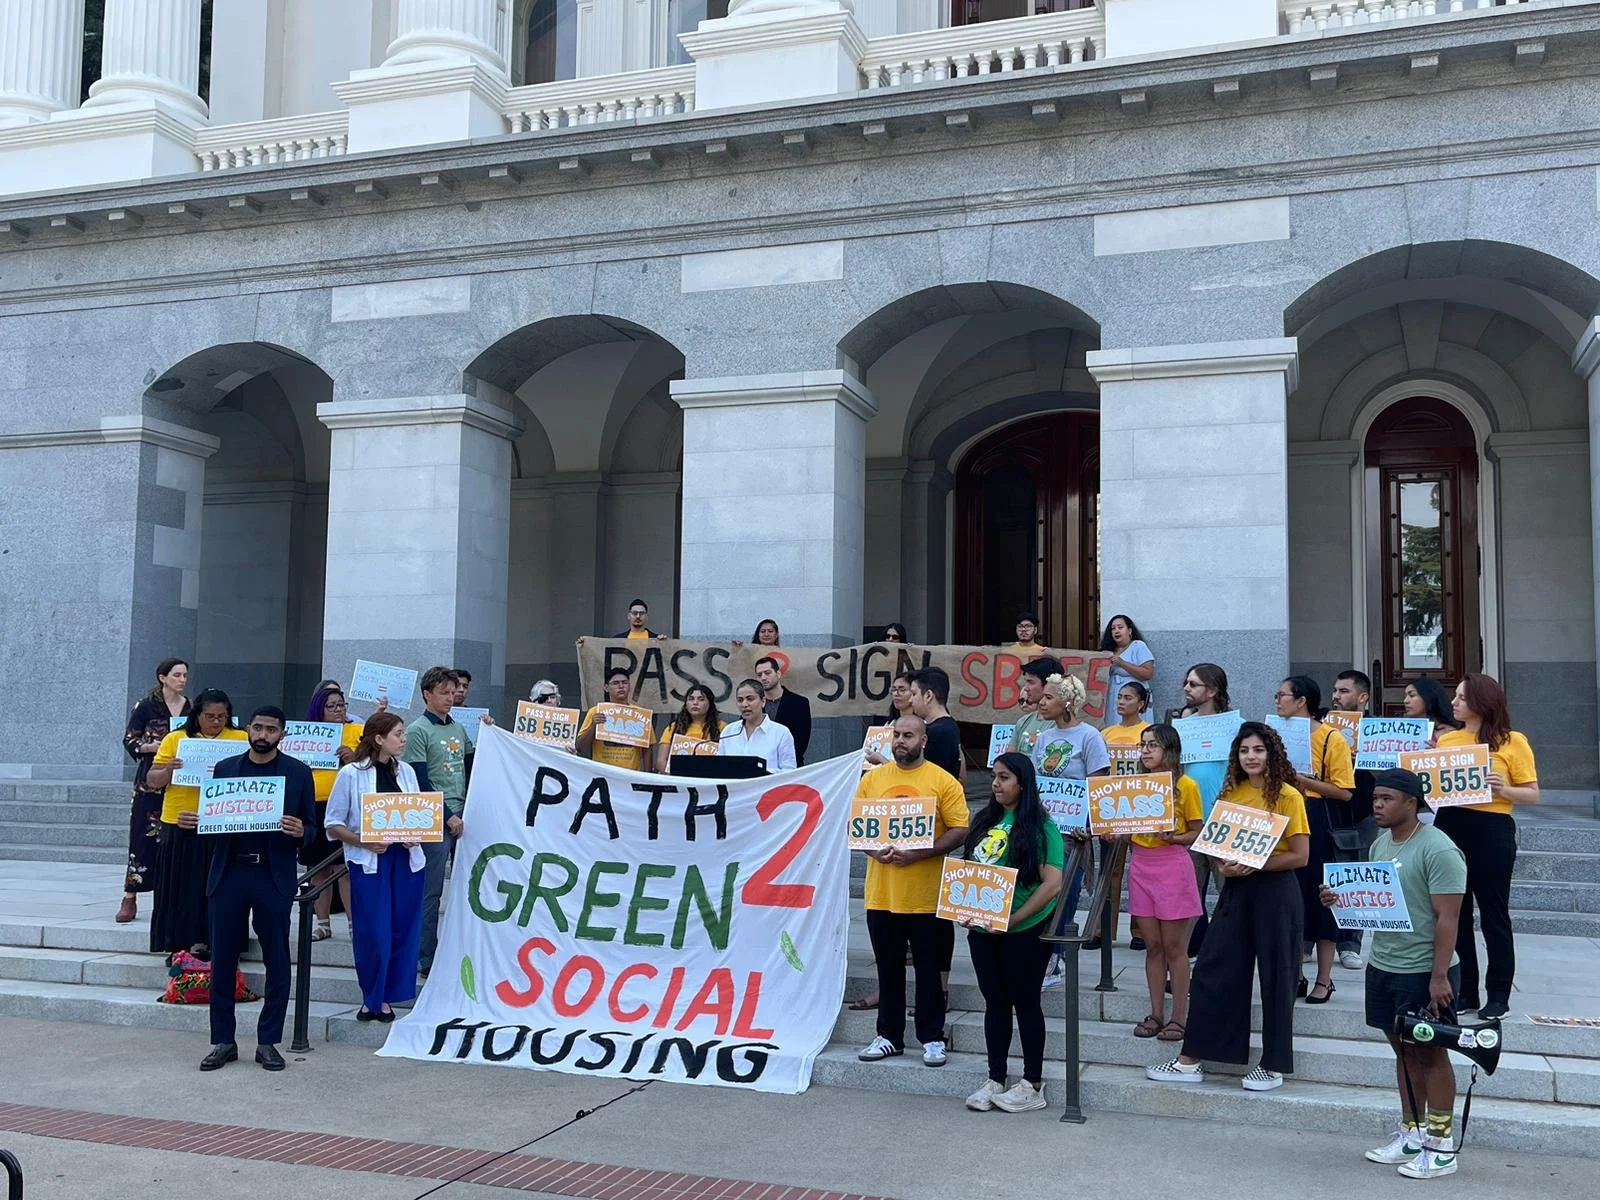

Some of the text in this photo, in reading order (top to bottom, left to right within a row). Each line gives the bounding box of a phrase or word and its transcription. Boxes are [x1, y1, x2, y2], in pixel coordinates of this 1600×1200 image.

[604, 647, 733, 704] PASS
[959, 652, 1022, 710] SB
[526, 708, 544, 718] PASS
[552, 712, 570, 721] SIGN
[634, 712, 650, 724] THAT
[286, 724, 335, 738] LIMATE
[517, 716, 576, 739] SB 555!
[1363, 721, 1422, 736] CLIMATE
[673, 741, 697, 750] SHOW
[867, 731, 891, 745] SHOW
[1362, 739, 1420, 752] JUSTICE
[1117, 750, 1123, 759] &
[1180, 752, 1197, 762] REEN
[1411, 753, 1474, 770] PASS & SIGN
[310, 760, 336, 768] HOUSING
[1417, 766, 1488, 794] B 555!
[205, 780, 277, 799] CLIMATE
[1038, 782, 1086, 798] LIMATE
[1090, 780, 1172, 801] SHOW ME THAT
[204, 799, 274, 816] JUSTICE
[363, 797, 442, 813] SHOW ME THAT
[862, 803, 923, 815] PASS & SIGN
[1042, 799, 1082, 816] STICE
[1098, 793, 1166, 820] SASS
[199, 821, 281, 833] GREEN SOCIAL HOUSING
[370, 809, 434, 830] SASS
[852, 815, 933, 839] SB 555!
[1219, 810, 1243, 825] PASS
[1243, 815, 1251, 826] &
[1251, 817, 1274, 832] SIGN
[526, 766, 824, 908] PATH 2
[1202, 821, 1278, 857] SB 555!
[944, 867, 1013, 893] SHOW ME THAT
[1328, 867, 1390, 888] CLIMATE
[468, 843, 741, 951] GREEN
[948, 881, 1006, 913] SASS
[1338, 918, 1410, 929] GREEN SOCIAL HOUSING
[495, 937, 775, 1040] SOCIAL
[428, 1018, 780, 1083] HOUSING
